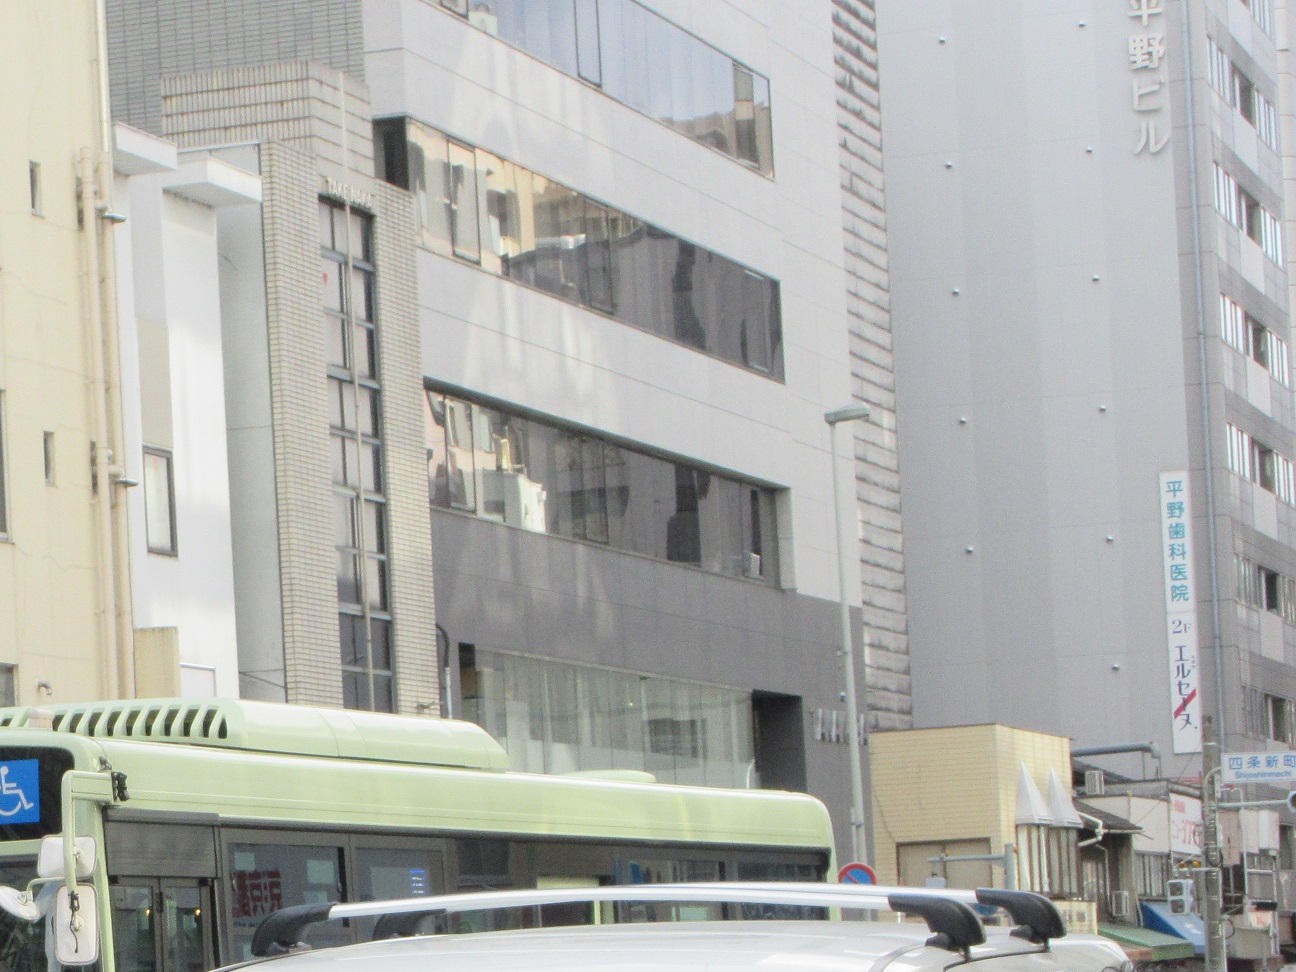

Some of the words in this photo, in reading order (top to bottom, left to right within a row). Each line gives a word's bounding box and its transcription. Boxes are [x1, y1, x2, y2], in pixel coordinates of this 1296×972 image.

[1128, 0, 1172, 155] 平野ビル
[1165, 479, 1190, 603] 平野歯科医院
[1172, 619, 1191, 634] 2F
